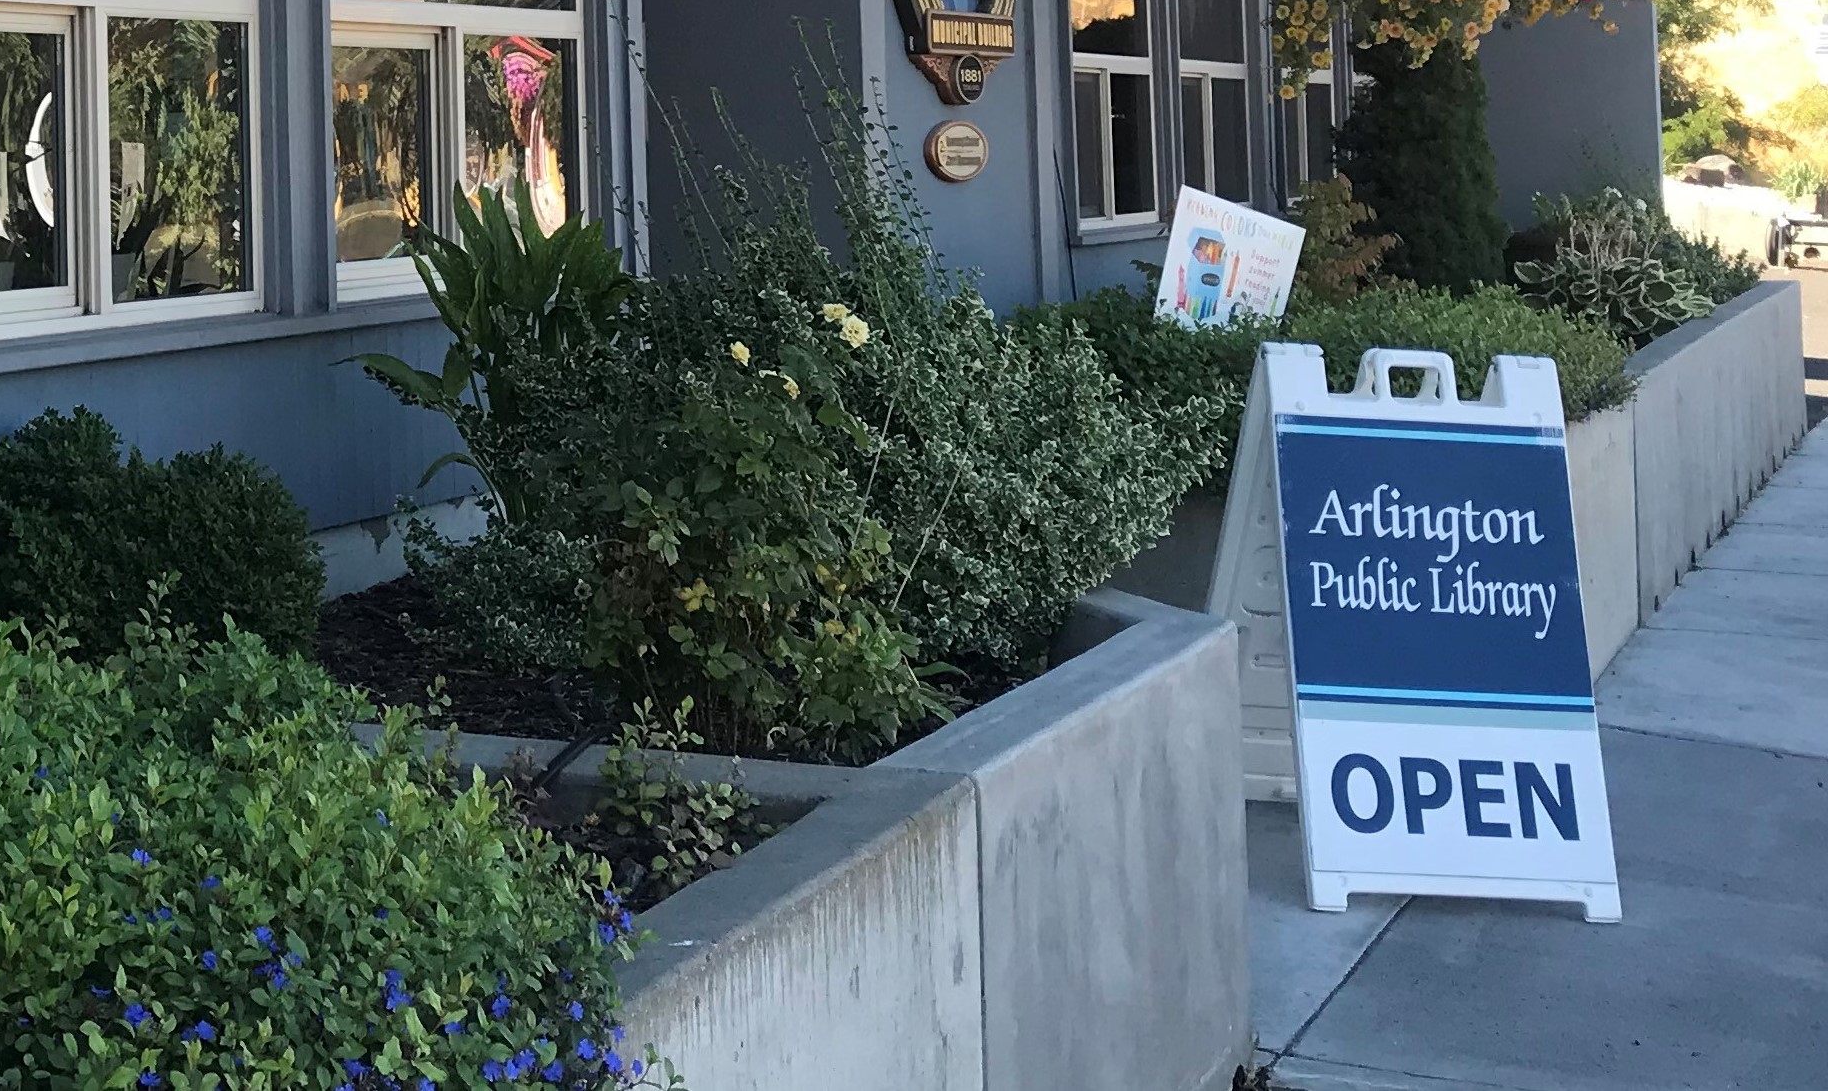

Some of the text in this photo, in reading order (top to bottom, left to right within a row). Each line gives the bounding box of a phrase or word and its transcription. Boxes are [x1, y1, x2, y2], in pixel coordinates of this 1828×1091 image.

[960, 69, 982, 83] 1881
[1308, 483, 1545, 563] Arlington
[1309, 556, 1557, 640] Public Library
[1330, 753, 1581, 841] OPEN
